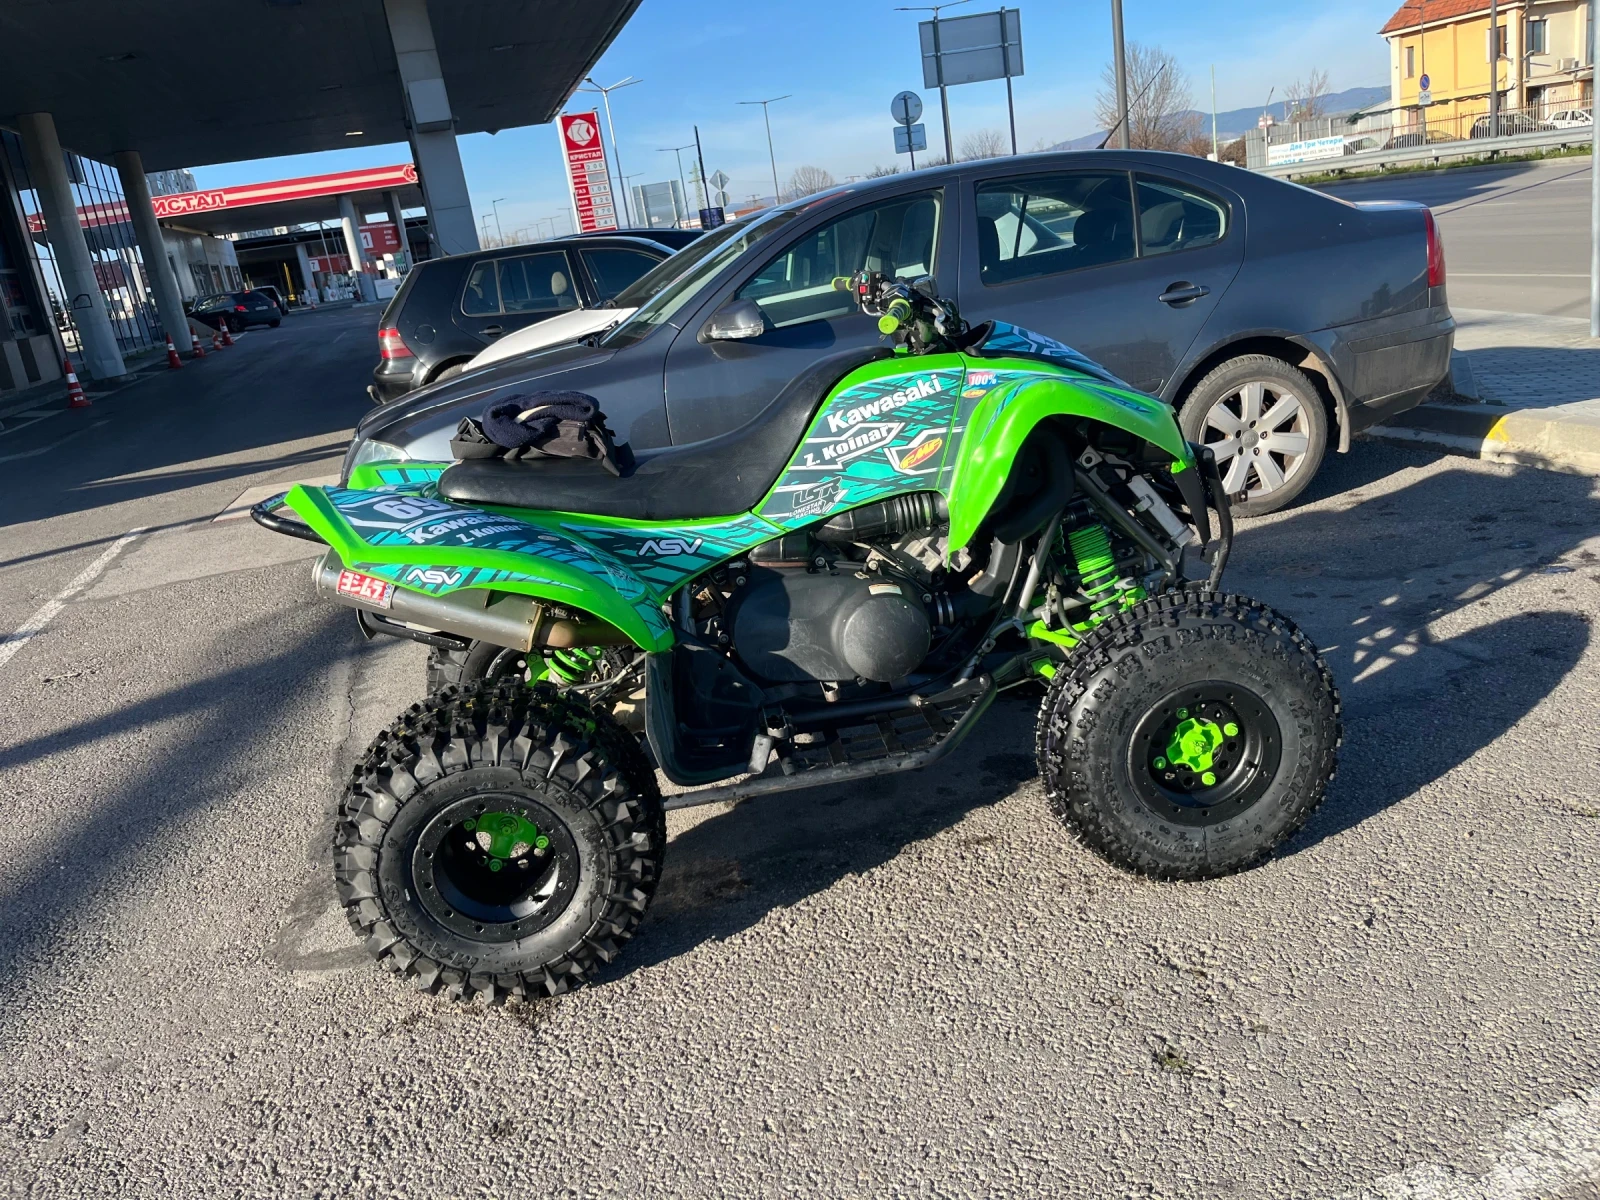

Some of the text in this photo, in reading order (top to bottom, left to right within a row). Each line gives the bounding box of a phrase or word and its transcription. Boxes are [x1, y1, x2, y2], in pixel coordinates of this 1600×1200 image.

[1304, 141, 1316, 149] Три
[1317, 138, 1343, 146] Четири
[569, 152, 601, 161] КРИСТАЛ
[363, 234, 370, 247] 1
[971, 374, 997, 386] 100%
[827, 374, 941, 432] Kawasaki
[803, 453, 821, 468] Z.
[900, 438, 942, 469] FMF
[373, 497, 451, 519] 69
[788, 501, 822, 518] LONESTAR
[795, 507, 822, 520] RACING
[639, 538, 703, 555] ASV
[339, 571, 385, 599] ヨシムラ
[407, 568, 461, 585] ASV
[1279, 699, 1313, 813] MAXXIS
